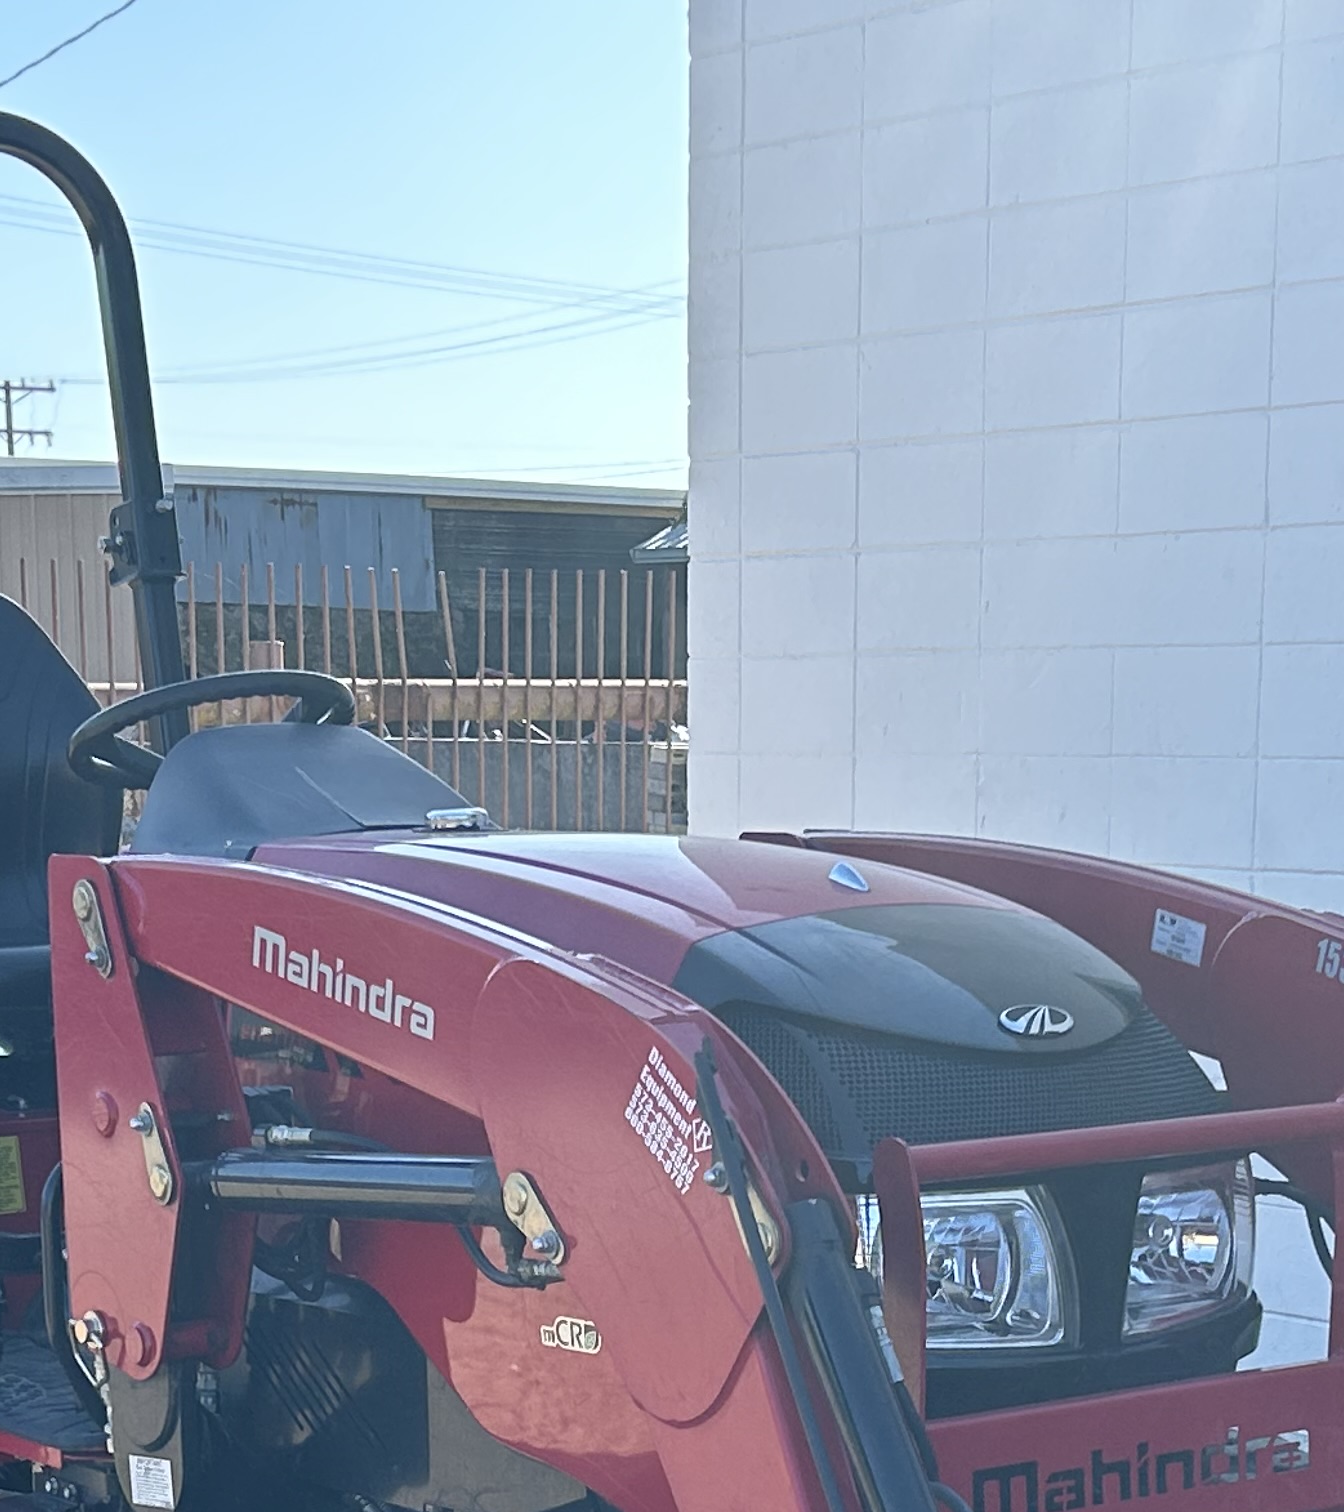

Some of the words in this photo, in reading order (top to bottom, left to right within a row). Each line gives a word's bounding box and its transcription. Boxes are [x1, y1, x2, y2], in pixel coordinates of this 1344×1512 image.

[252, 925, 435, 1041] Mahindra
[639, 1064, 693, 1140] Equipment
[648, 1045, 697, 1116] Diamond
